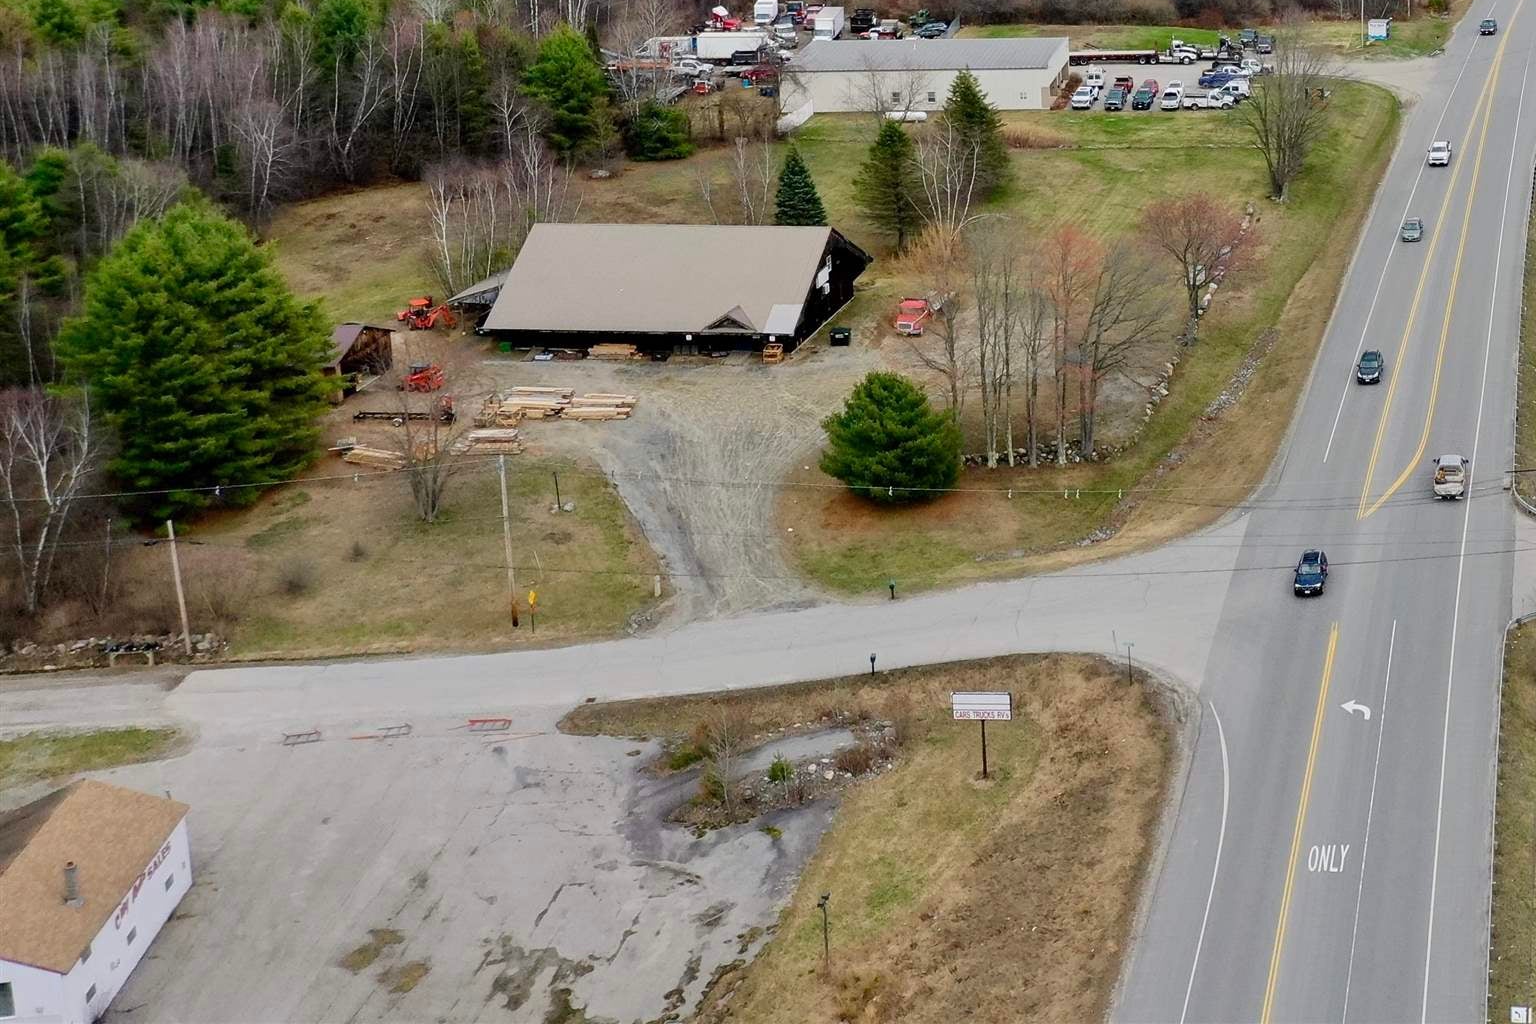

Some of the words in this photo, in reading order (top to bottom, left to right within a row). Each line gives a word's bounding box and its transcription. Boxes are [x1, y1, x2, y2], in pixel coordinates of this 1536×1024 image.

[955, 711, 970, 719] CARS
[973, 711, 995, 719] TRUCKS
[1308, 844, 1350, 872] ONLY
